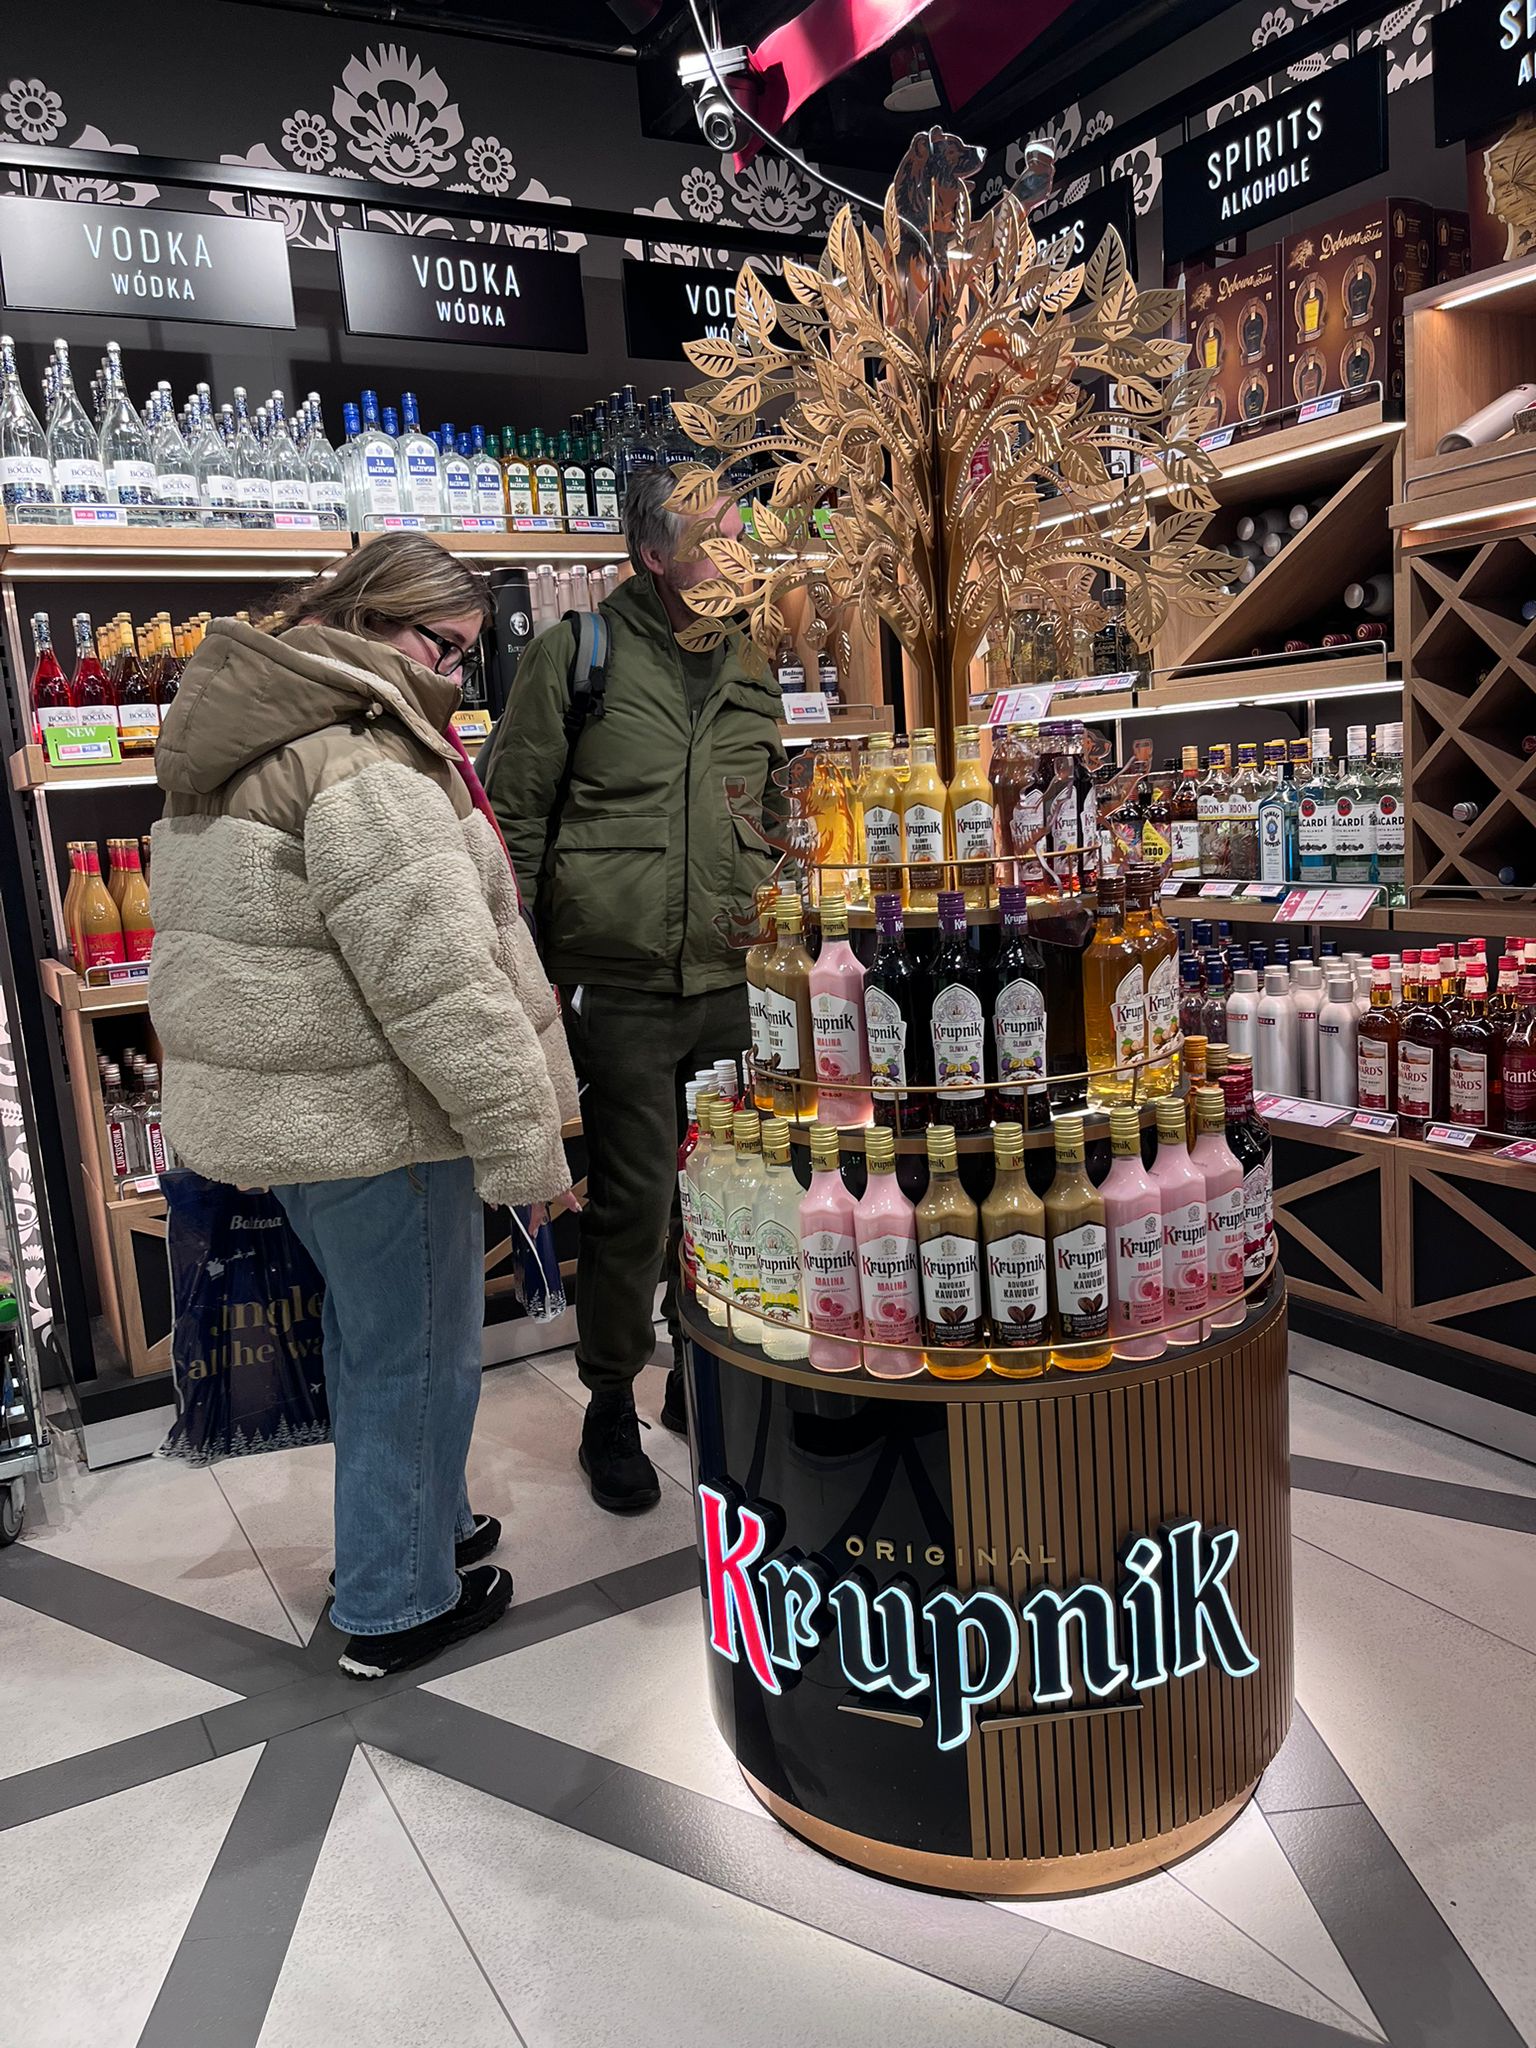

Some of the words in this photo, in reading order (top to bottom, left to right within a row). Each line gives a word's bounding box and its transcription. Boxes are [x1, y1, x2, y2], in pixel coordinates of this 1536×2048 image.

[1206, 99, 1325, 190] SPIRITS
[1219, 154, 1312, 221] ALKOHOLE
[82, 223, 213, 269] VODKA
[111, 269, 195, 301] WÓDKA
[412, 254, 521, 298] VODKA
[436, 298, 506, 328] WÓDKA
[685, 283, 759, 320] VOD
[65, 727, 97, 738] NEW
[1299, 816, 1328, 827] CARDÍ
[1335, 815, 1364, 827] CARDÍ
[813, 1013, 855, 1035] rupnik
[867, 1025, 902, 1041] rupnik
[933, 1022, 983, 1042] Krupnik
[996, 1016, 1045, 1037] Krupnik
[112, 1128, 126, 1169] LUKSUSOWA
[151, 1128, 165, 1169] LUKSUSOWA
[803, 1249, 857, 1274] Krupnik
[862, 1253, 917, 1279] Krupnik
[922, 1255, 978, 1279] Krupnik
[990, 1254, 1046, 1279] Krupnik
[815, 1276, 845, 1286] MALINA
[877, 1281, 908, 1292] MALINA
[938, 1281, 966, 1289] ADVOKAT
[1003, 1286, 1039, 1298] KAWOWY
[1007, 1279, 1034, 1288] ADVOKAT
[935, 1288, 971, 1299] KAWOWY
[845, 1536, 1057, 1566] ORIGINAL
[698, 1484, 1260, 1751] Krupnik
